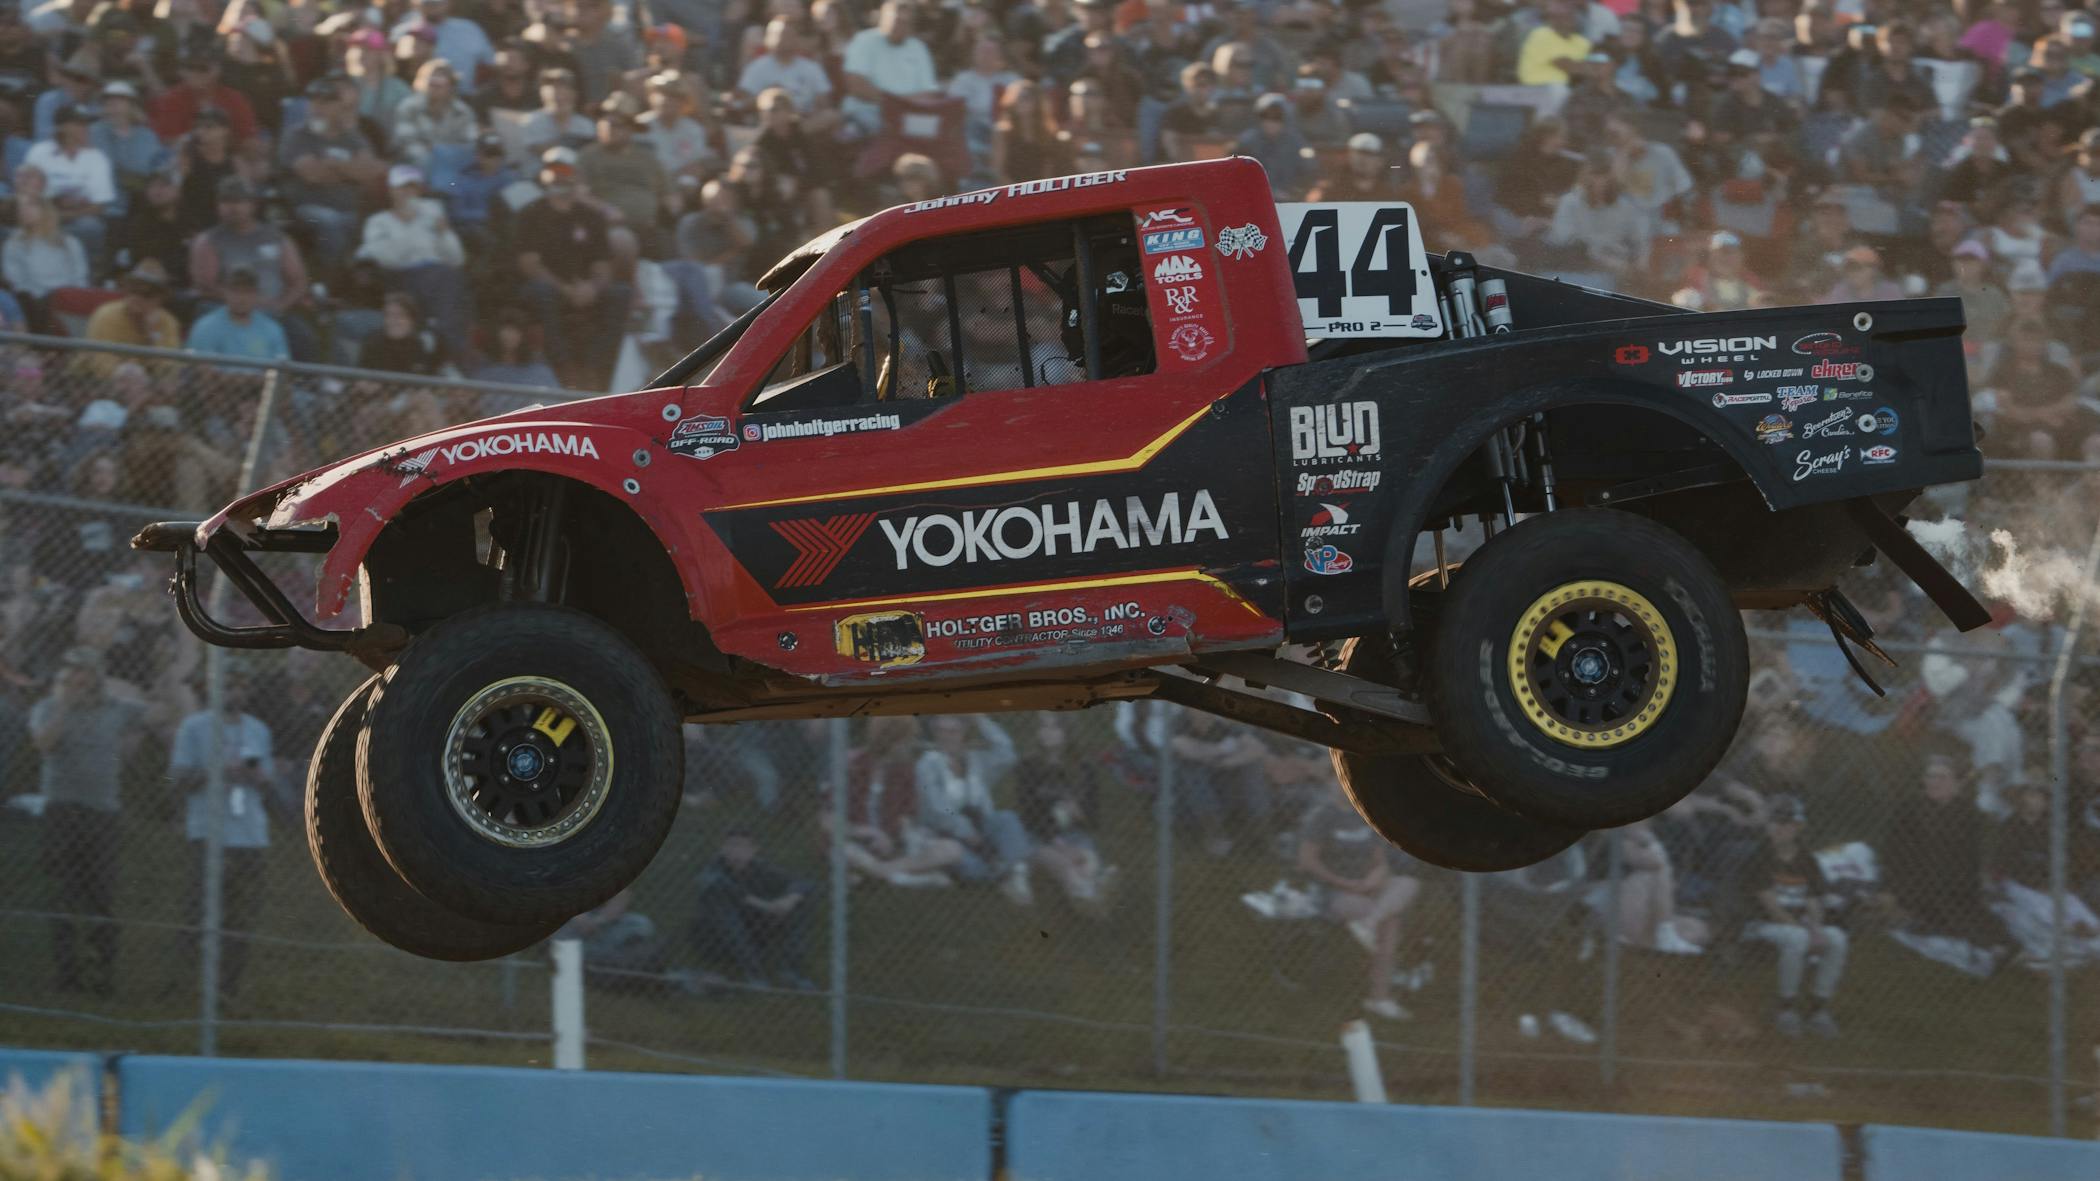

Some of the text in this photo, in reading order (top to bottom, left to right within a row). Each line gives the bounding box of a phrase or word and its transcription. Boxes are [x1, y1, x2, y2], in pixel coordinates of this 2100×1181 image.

[904, 171, 1128, 214] Johnny HOLTGER
[1147, 229, 1201, 246] KING
[1154, 255, 1202, 277] MAC
[1289, 207, 1418, 318] 44
[1155, 272, 1203, 284] TOOLS
[1164, 285, 1200, 314] R&R
[1329, 321, 1382, 333] PRO 2
[1658, 336, 1777, 355] VISION
[1681, 354, 1760, 365] WHEEL
[1776, 385, 1818, 399] TEAM
[762, 413, 900, 442] johnholtgerracing
[1289, 401, 1381, 460] BLUD
[441, 433, 600, 465] YOKOHAMA
[1871, 448, 1890, 457] RFC
[1293, 454, 1382, 467] LUBRICANTS
[1296, 469, 1381, 496] SpdStrap
[878, 489, 1229, 570] YOKOHAMA
[1300, 523, 1361, 538] IMPACT
[1304, 545, 1339, 573] VP
[926, 613, 1022, 639] HOLTGER
[1104, 602, 1146, 621] INC.
[994, 630, 1067, 645] CTRACTOR
[1071, 628, 1099, 639] Since
